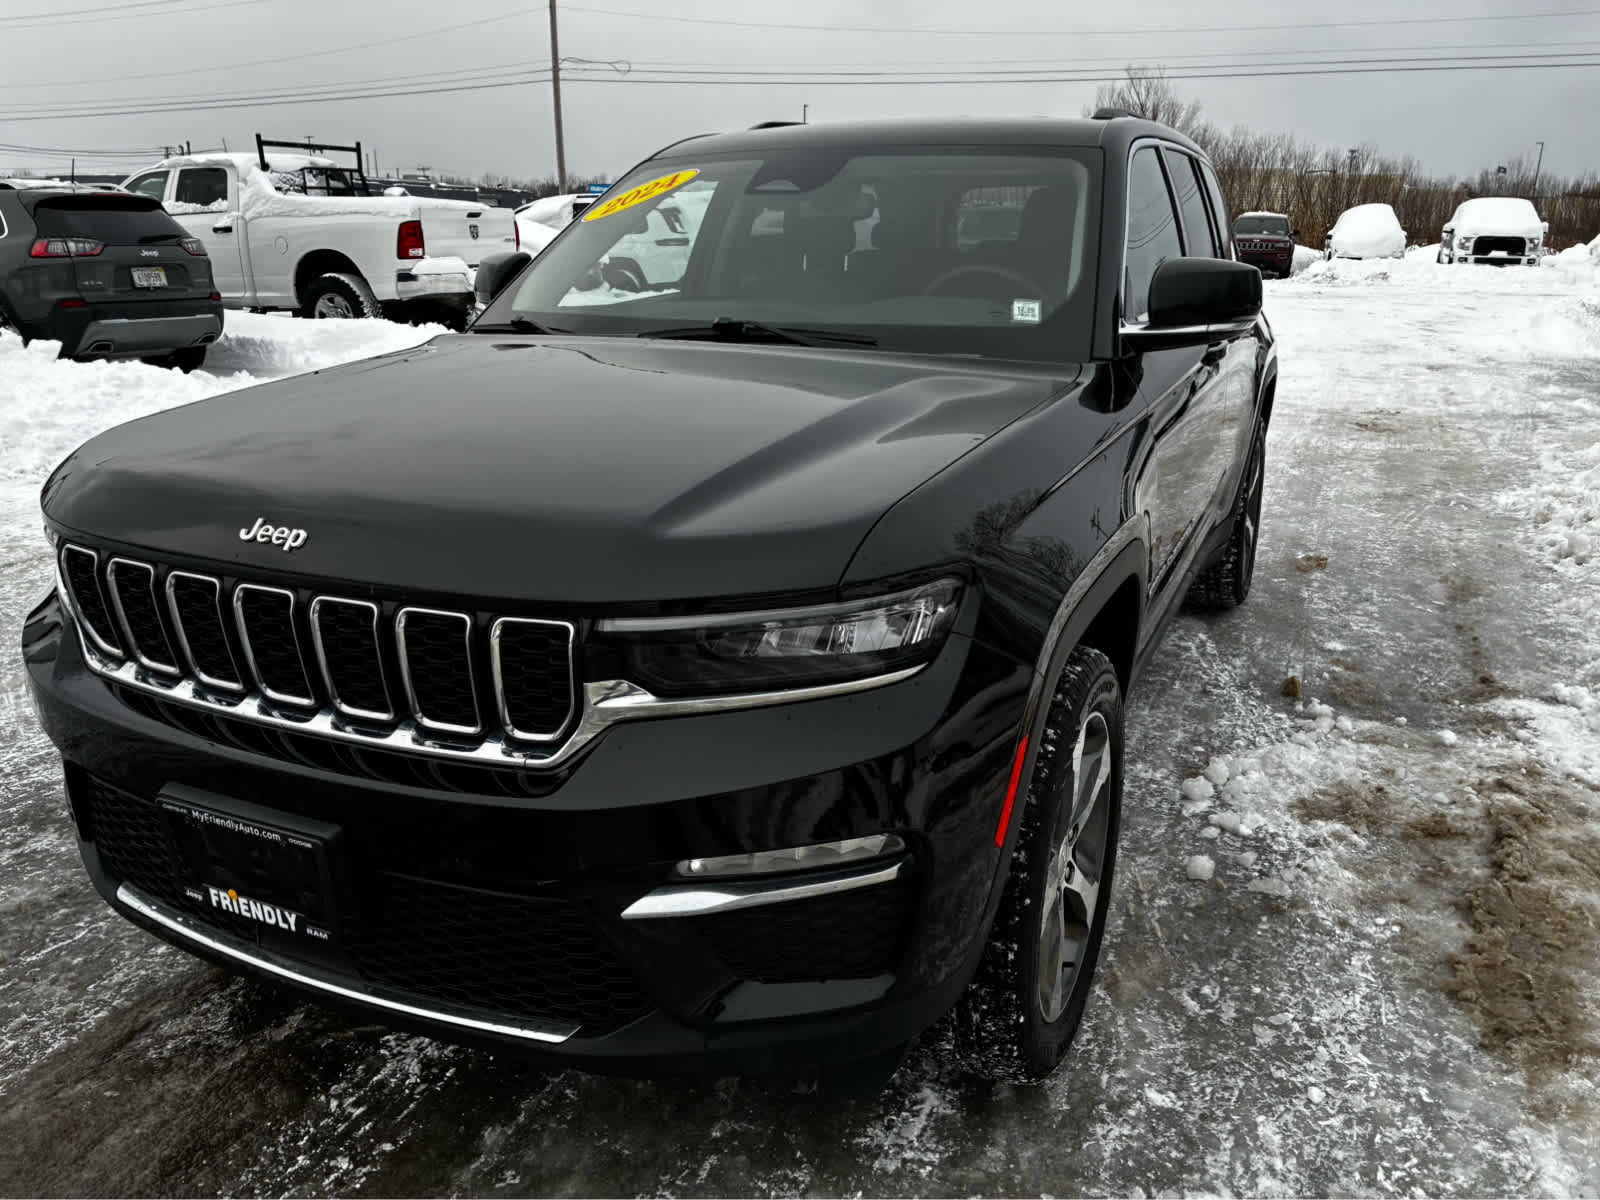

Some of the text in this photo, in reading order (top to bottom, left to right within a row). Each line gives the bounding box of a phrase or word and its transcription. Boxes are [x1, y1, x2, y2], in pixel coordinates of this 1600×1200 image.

[600, 174, 681, 216] 2024
[140, 249, 159, 257] Jeep
[239, 517, 308, 551] Jeep
[191, 809, 281, 840] MyFriendlyAuto.com
[209, 887, 297, 932] FRIENDLY
[306, 927, 329, 940] RAM
